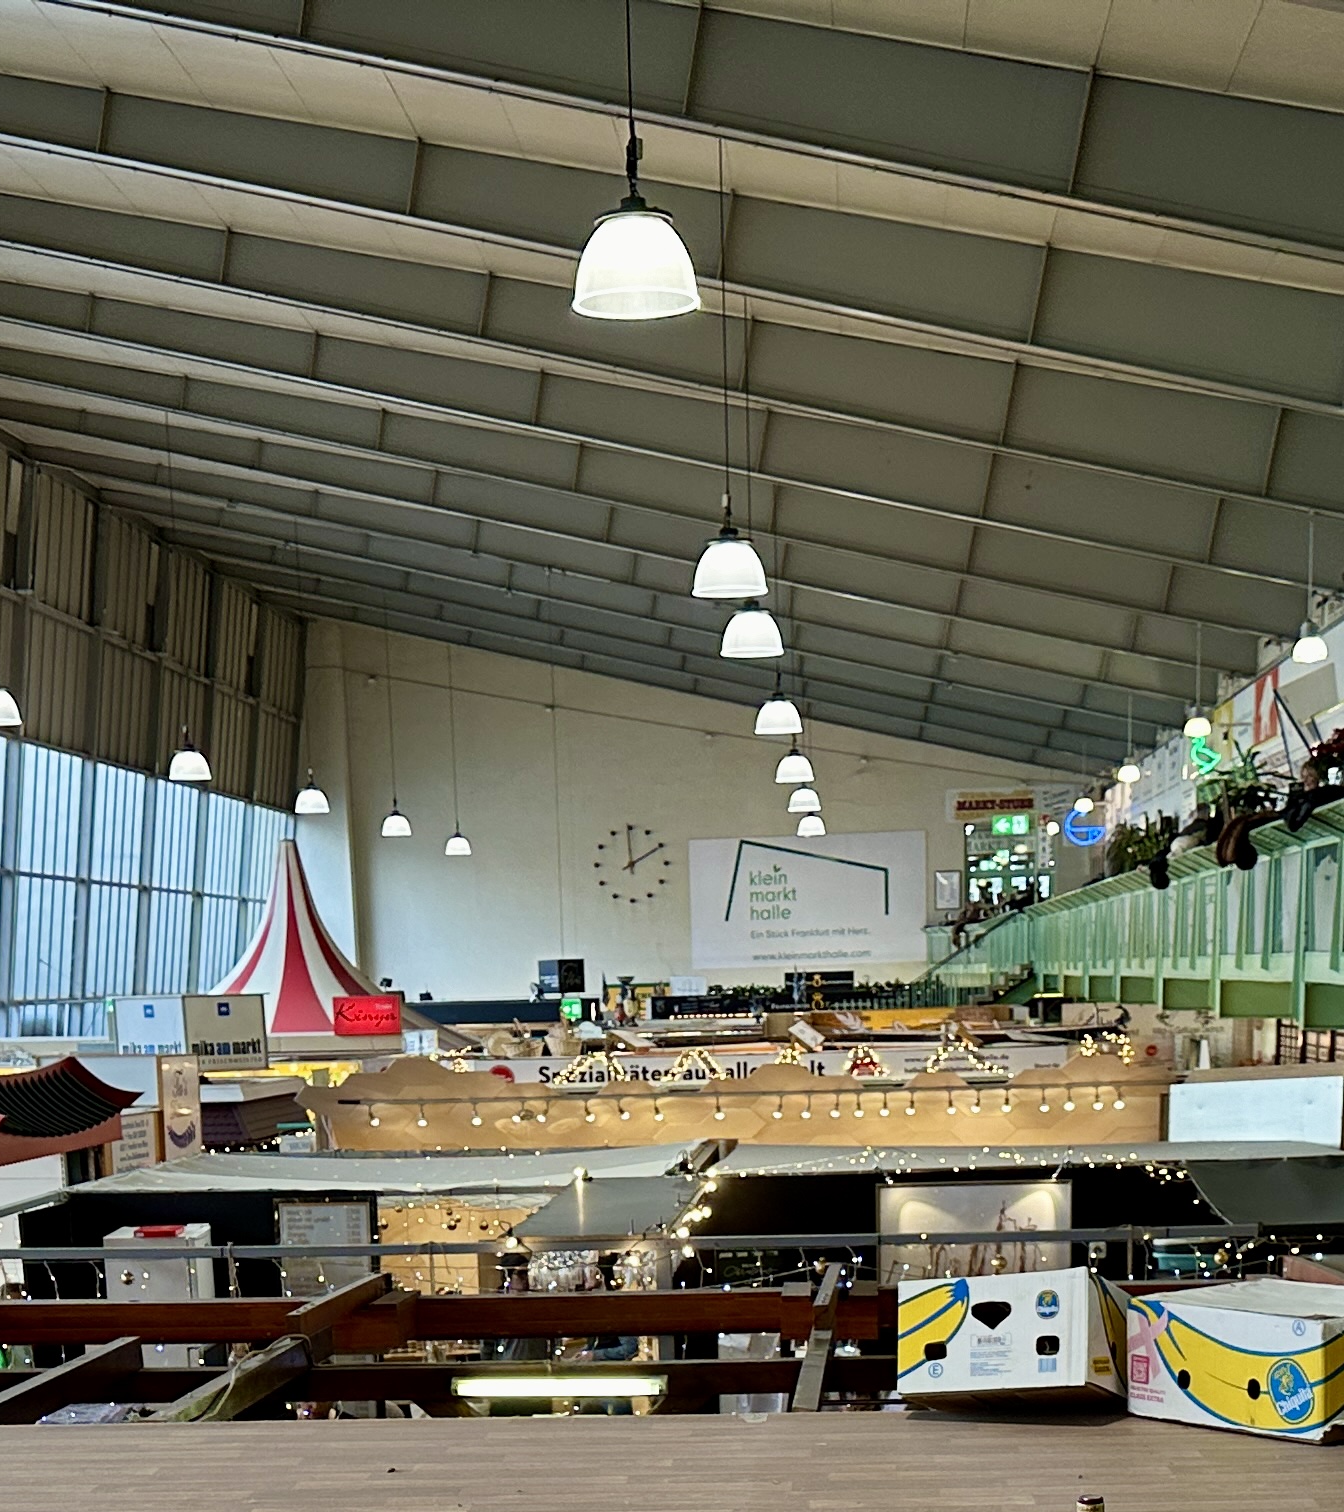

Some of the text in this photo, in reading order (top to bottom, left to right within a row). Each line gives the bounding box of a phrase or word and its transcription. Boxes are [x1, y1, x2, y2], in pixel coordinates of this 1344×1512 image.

[749, 865, 788, 886] klein
[749, 887, 797, 903] markt
[750, 904, 792, 920] halle
[231, 1042, 256, 1055] am
[233, 1038, 262, 1055] markt
[1277, 1385, 1313, 1416] Chiquita
